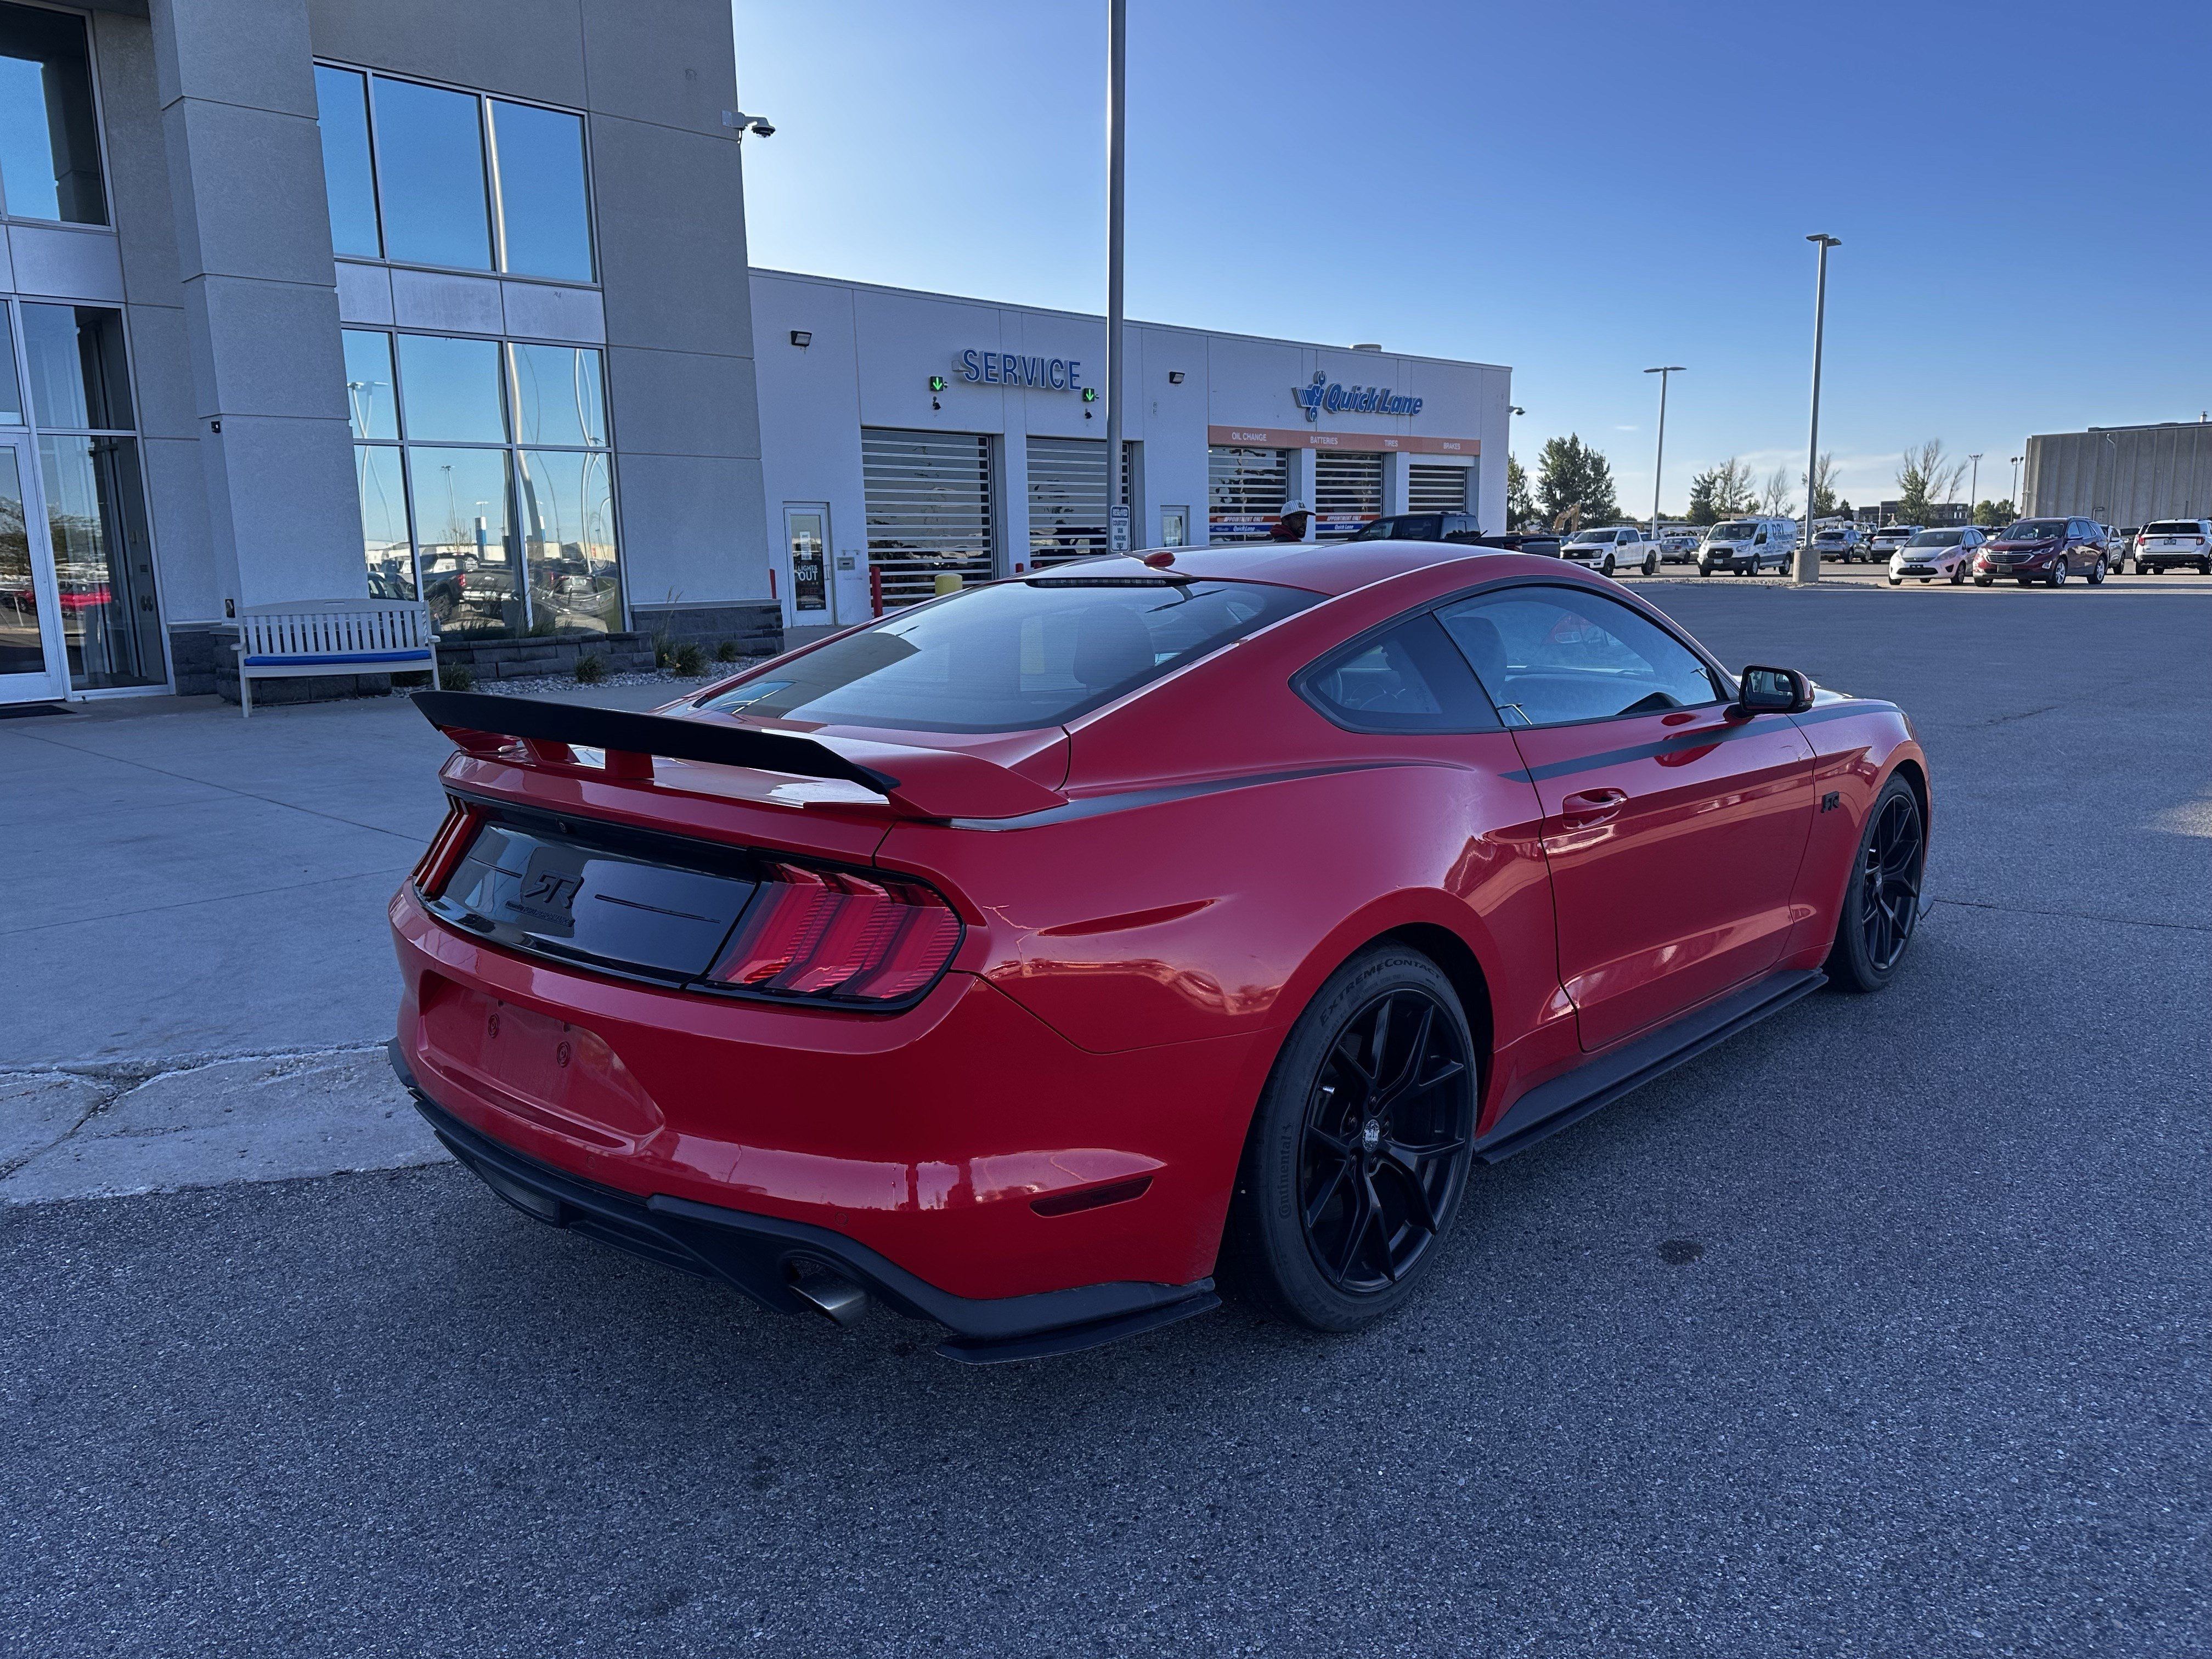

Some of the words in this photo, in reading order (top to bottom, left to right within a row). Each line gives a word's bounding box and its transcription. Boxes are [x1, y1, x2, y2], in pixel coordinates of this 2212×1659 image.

[963, 348, 1081, 391] SERVICE
[1327, 383, 1381, 414] Quick
[1379, 387, 1424, 415] Lane
[1232, 432, 1242, 441] OIL
[1243, 432, 1267, 442] CHANGE
[1310, 436, 1338, 445] BATTERIES
[799, 571, 818, 582] OUT
